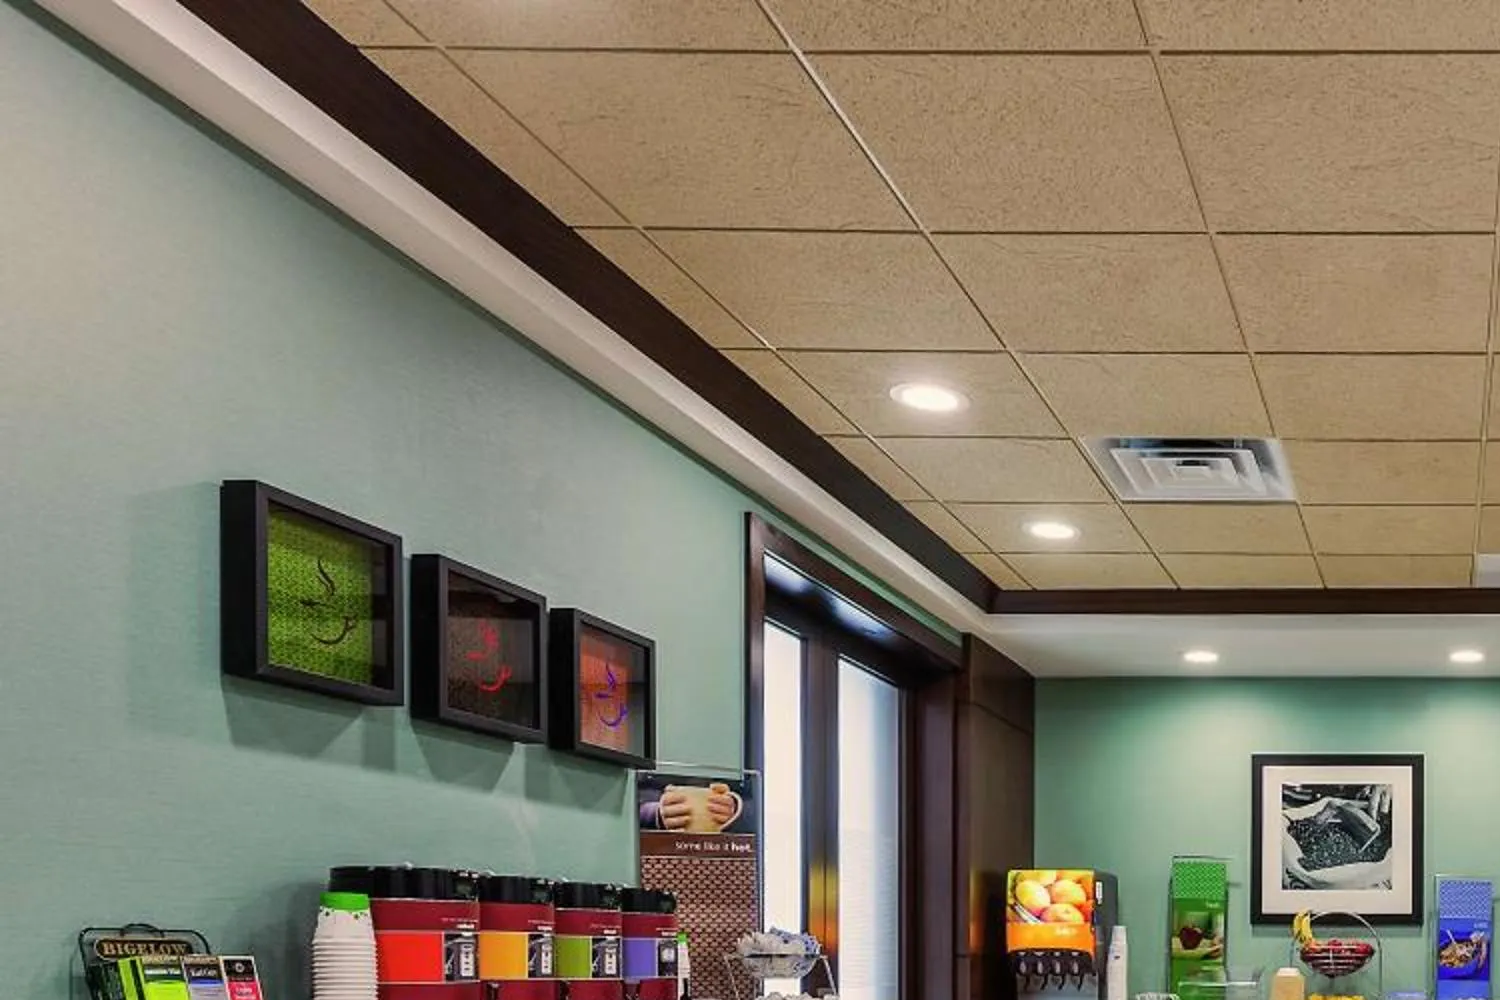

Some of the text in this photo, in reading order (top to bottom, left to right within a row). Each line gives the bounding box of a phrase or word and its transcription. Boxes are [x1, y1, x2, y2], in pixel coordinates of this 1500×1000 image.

[675, 841, 701, 851] some
[703, 841, 721, 851] like
[103, 942, 188, 956] BIGELOW
